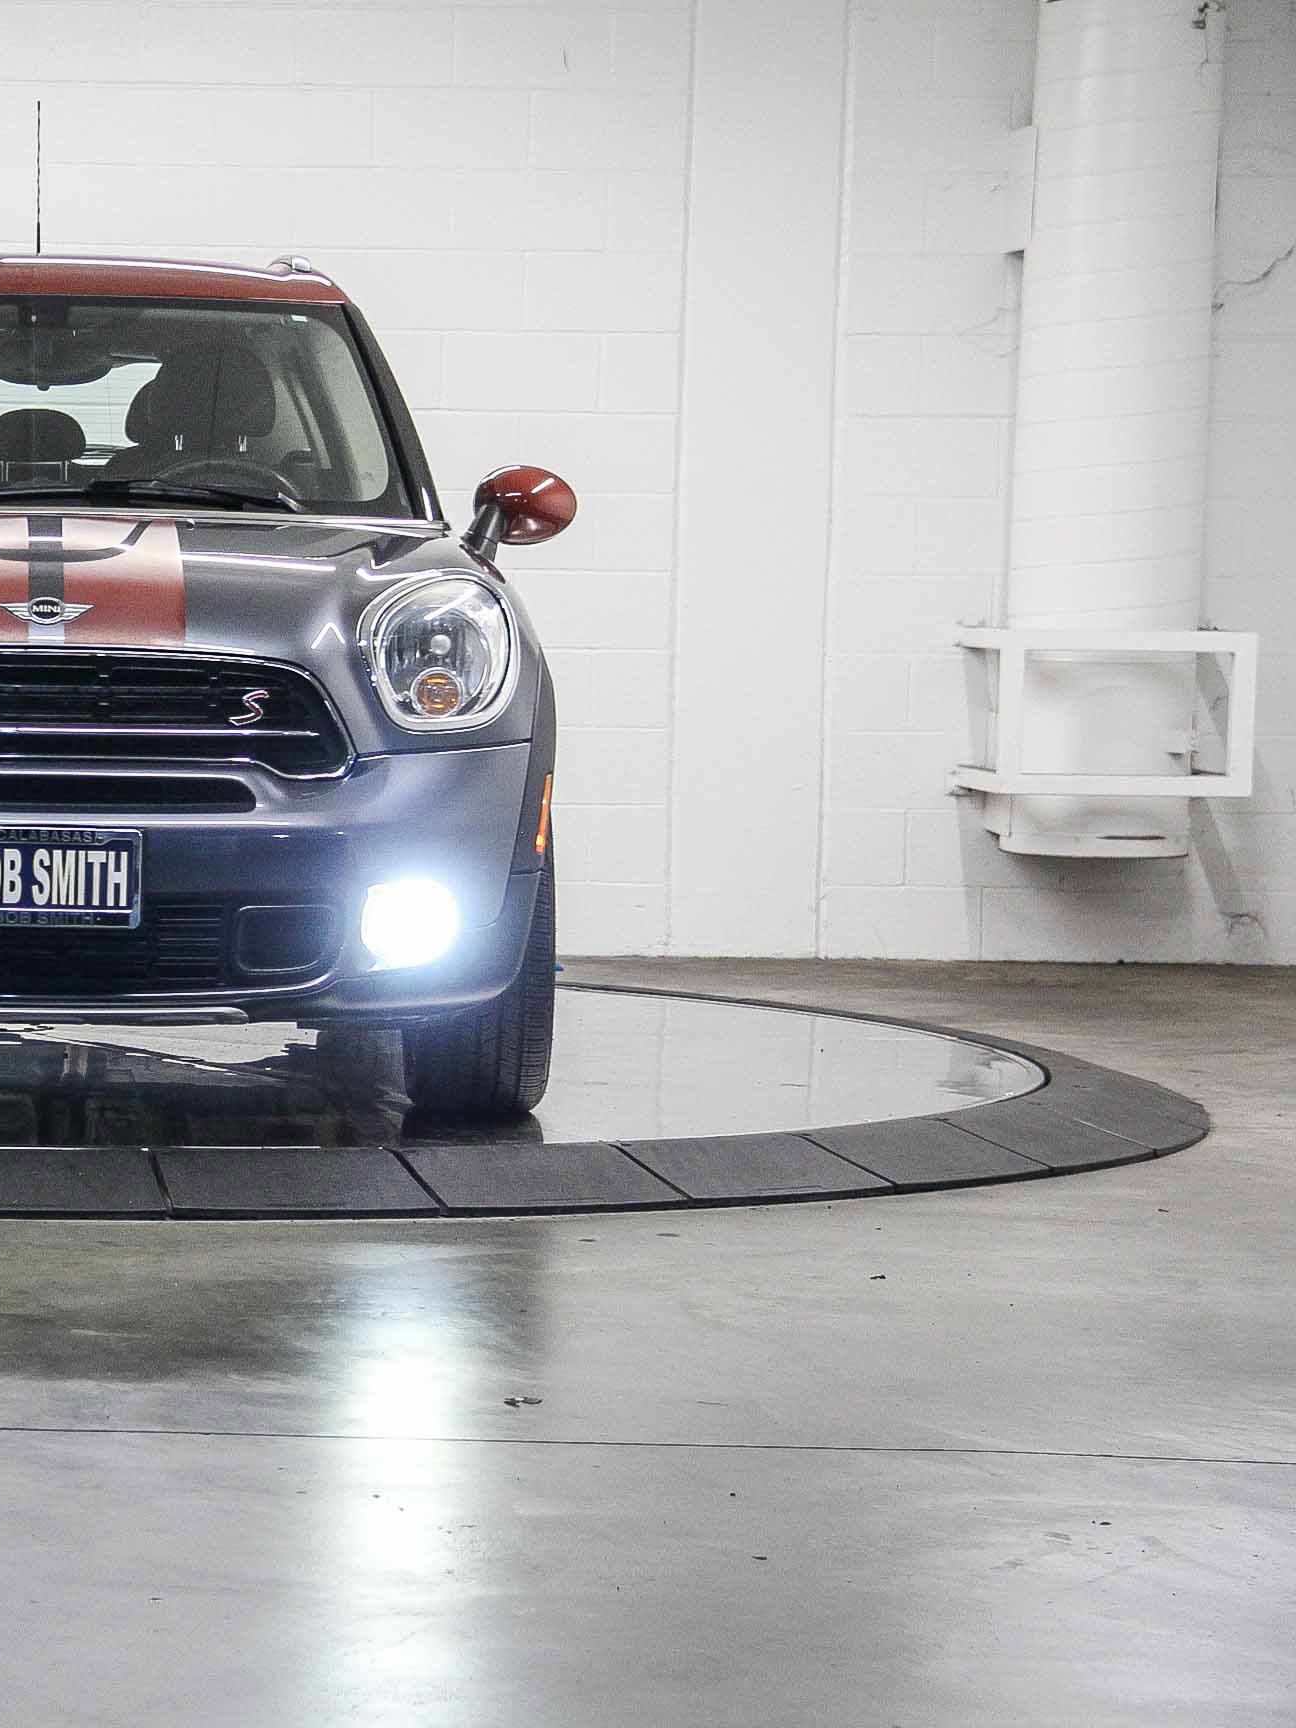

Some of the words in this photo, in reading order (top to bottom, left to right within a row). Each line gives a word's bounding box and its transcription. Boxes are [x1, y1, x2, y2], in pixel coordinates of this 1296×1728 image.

[31, 604, 61, 613] MINI
[229, 689, 270, 726] S
[31, 848, 129, 907] SMITH
[36, 912, 95, 926] SMITH
